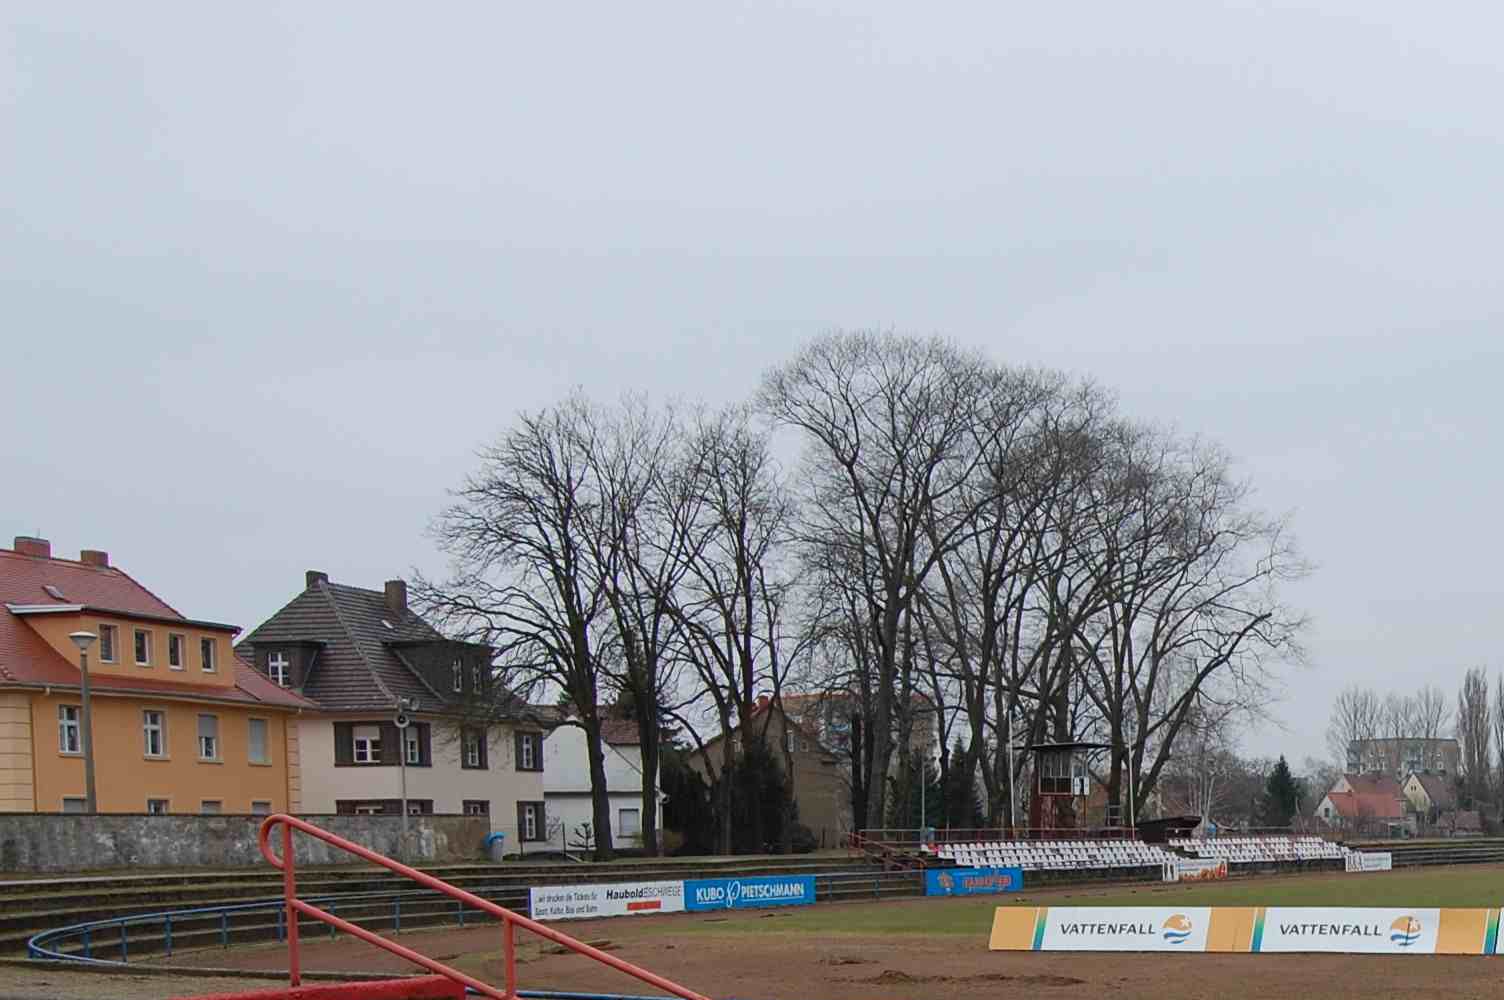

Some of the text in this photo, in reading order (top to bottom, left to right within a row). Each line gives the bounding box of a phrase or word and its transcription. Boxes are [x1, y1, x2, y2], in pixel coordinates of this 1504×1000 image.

[696, 887, 725, 902] KUBO
[741, 882, 805, 899] PIETSCHMANN
[1059, 922, 1156, 936] VATTENFALL
[1278, 922, 1383, 937] VATTENFALL
